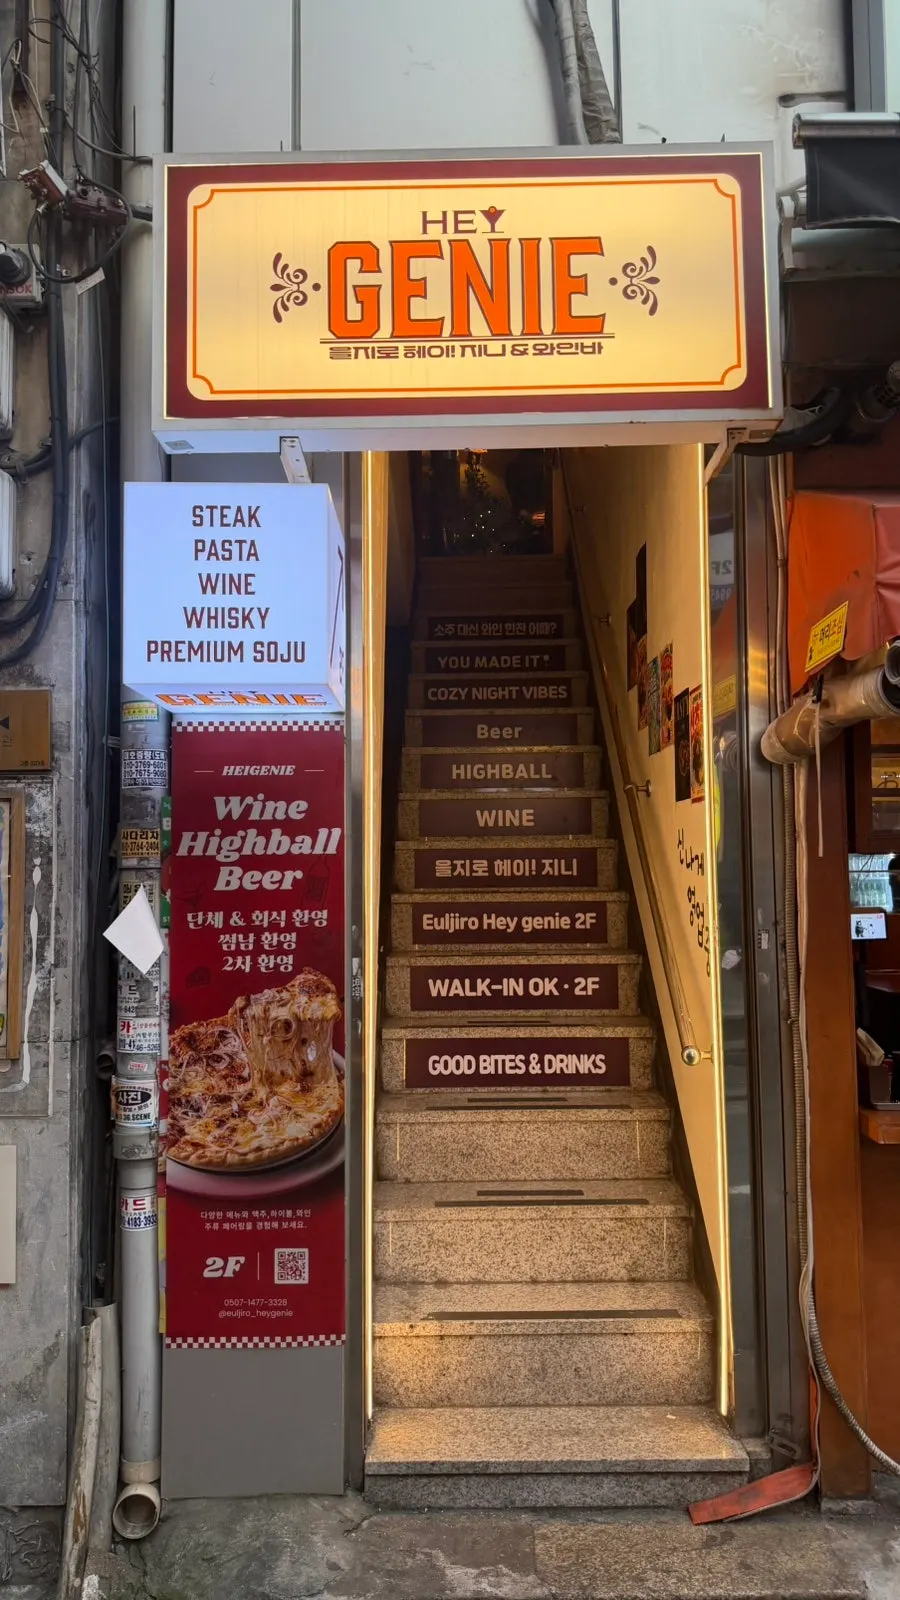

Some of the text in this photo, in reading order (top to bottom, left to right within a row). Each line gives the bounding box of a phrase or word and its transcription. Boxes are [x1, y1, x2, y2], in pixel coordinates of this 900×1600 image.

[420, 206, 506, 235] HEY
[326, 236, 606, 339] GENIE
[329, 341, 604, 360] 을지로 헤이! 지니 & 와인바
[192, 505, 261, 528] STEAK
[194, 539, 260, 561] PASTA
[198, 572, 256, 595] WINE
[183, 606, 270, 629] WHISKY
[434, 623, 456, 636] 소주
[457, 623, 479, 636] 대신
[481, 622, 502, 636] 와인
[146, 640, 306, 663] PREMIUM SOJU
[437, 656, 470, 669] YOU
[474, 655, 521, 669] MADE
[427, 685, 567, 700] COZY NIGHT VIBES
[477, 724, 522, 739] Beer
[222, 765, 296, 776] HEIGENIE
[451, 763, 552, 780] HIGHBALL
[213, 793, 308, 821] Wine
[476, 809, 535, 827] WINE
[176, 828, 342, 863] Highball
[435, 858, 578, 877] 을지로 헤이! 지니
[214, 866, 303, 891] Beer
[187, 910, 224, 929] 단체
[229, 911, 246, 926] &
[251, 909, 286, 928] 회식
[292, 908, 328, 928] 환영
[422, 912, 597, 933] Euljiro Hey genie 2F
[218, 931, 297, 951] 썸남 환영
[222, 954, 294, 973] 2차 환영
[428, 976, 600, 997] WALK-IN OK 2F
[428, 1053, 606, 1075] GOOD BITES & DRINKS
[200, 1210, 222, 1219] 다양한
[226, 1210, 249, 1219] 메뉴와
[204, 1222, 219, 1231] 주류
[202, 1256, 246, 1278] 2F
[218, 1309, 294, 1319] @euljiro_heygenie
